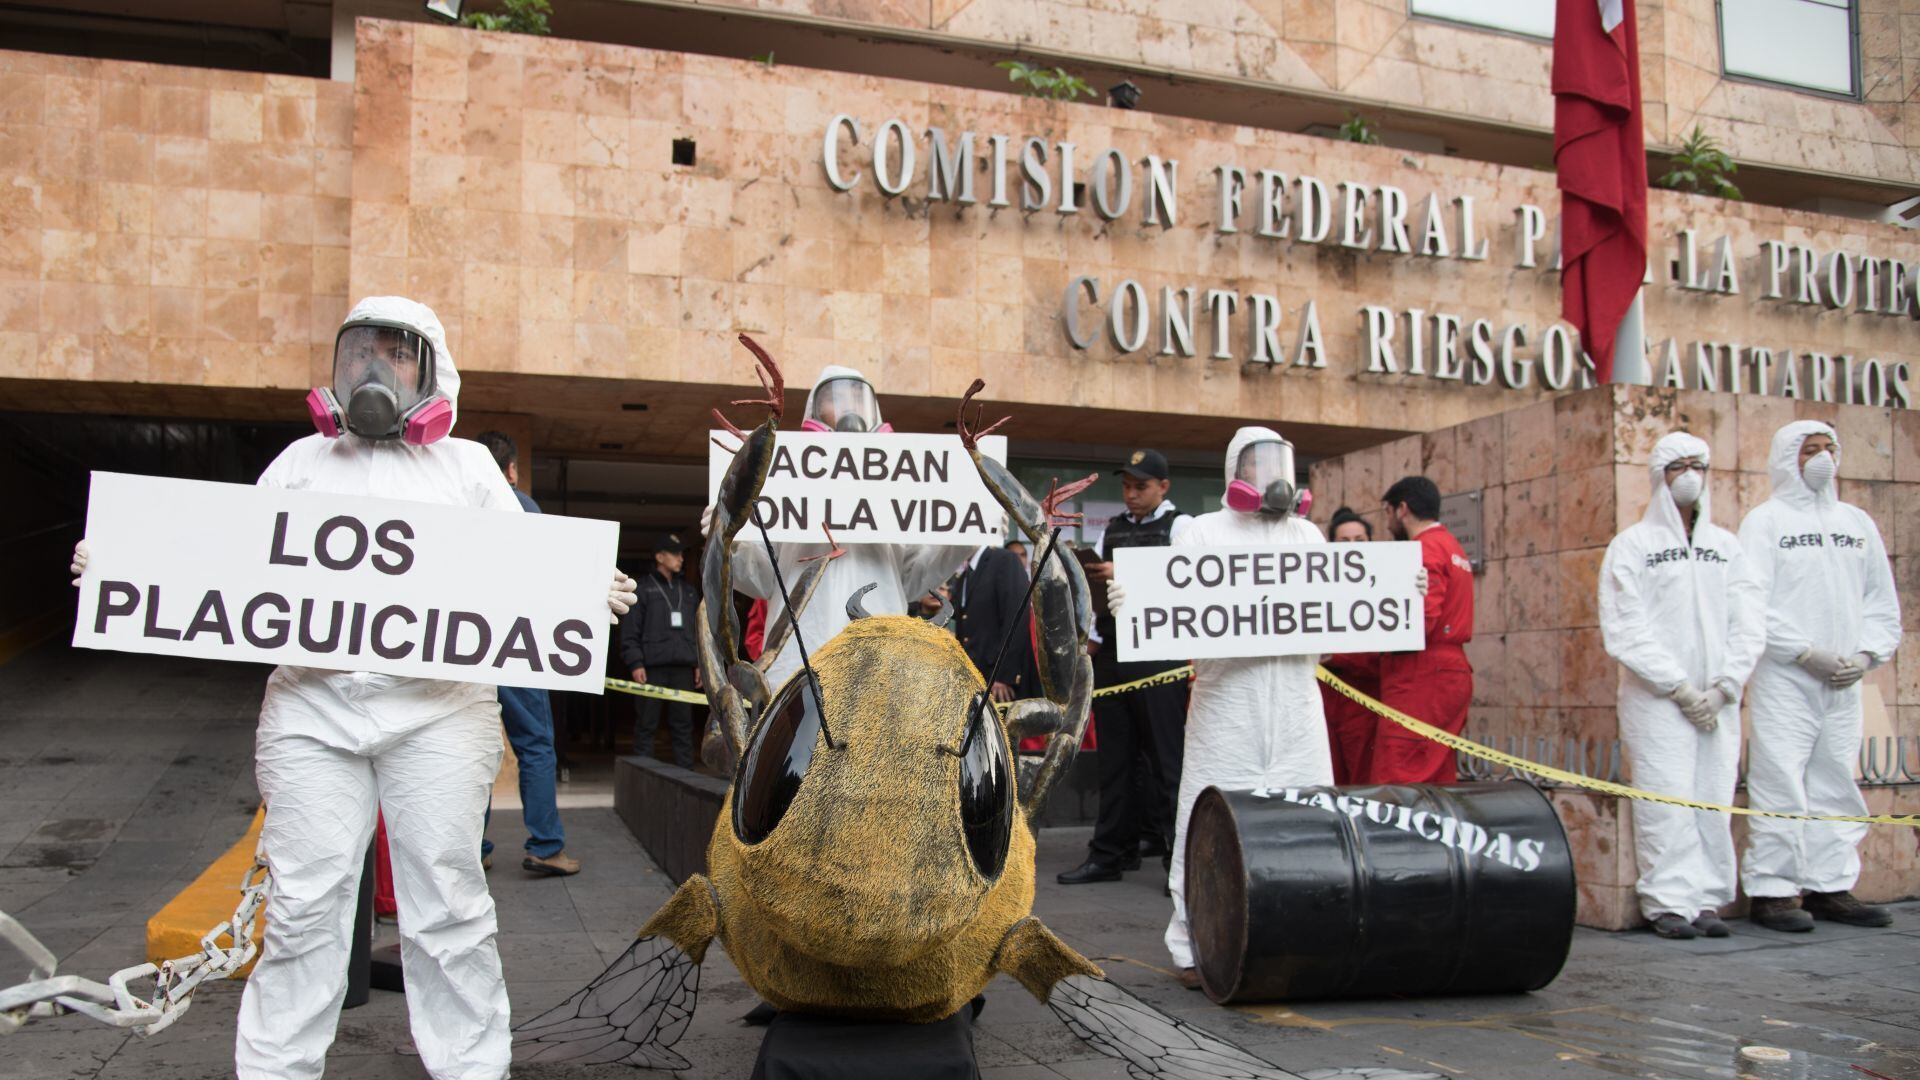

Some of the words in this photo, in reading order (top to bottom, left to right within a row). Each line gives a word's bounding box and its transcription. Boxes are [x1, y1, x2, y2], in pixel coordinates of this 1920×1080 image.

[823, 114, 1179, 229] COMISION
[1215, 164, 1489, 262] FEDERAL
[1679, 228, 1739, 294] LA
[1760, 240, 1920, 321] PROTE
[1064, 276, 1328, 369] CONTRA
[1645, 336, 1912, 410] ANITARIOS
[768, 445, 949, 483] ACABAN
[748, 495, 808, 531] ON
[824, 498, 878, 531] LA
[891, 499, 998, 534] VIDA.
[269, 511, 415, 576] LOS
[1646, 547, 1689, 568] GREEN
[1778, 533, 1823, 550] GREEN
[1166, 550, 1377, 588] COFEPRIS,
[94, 580, 593, 676] PLAGUICIDAS
[1131, 596, 1411, 649] ¡PROHÍBELOS!
[1251, 786, 1545, 873] PLAGUICIDAS
